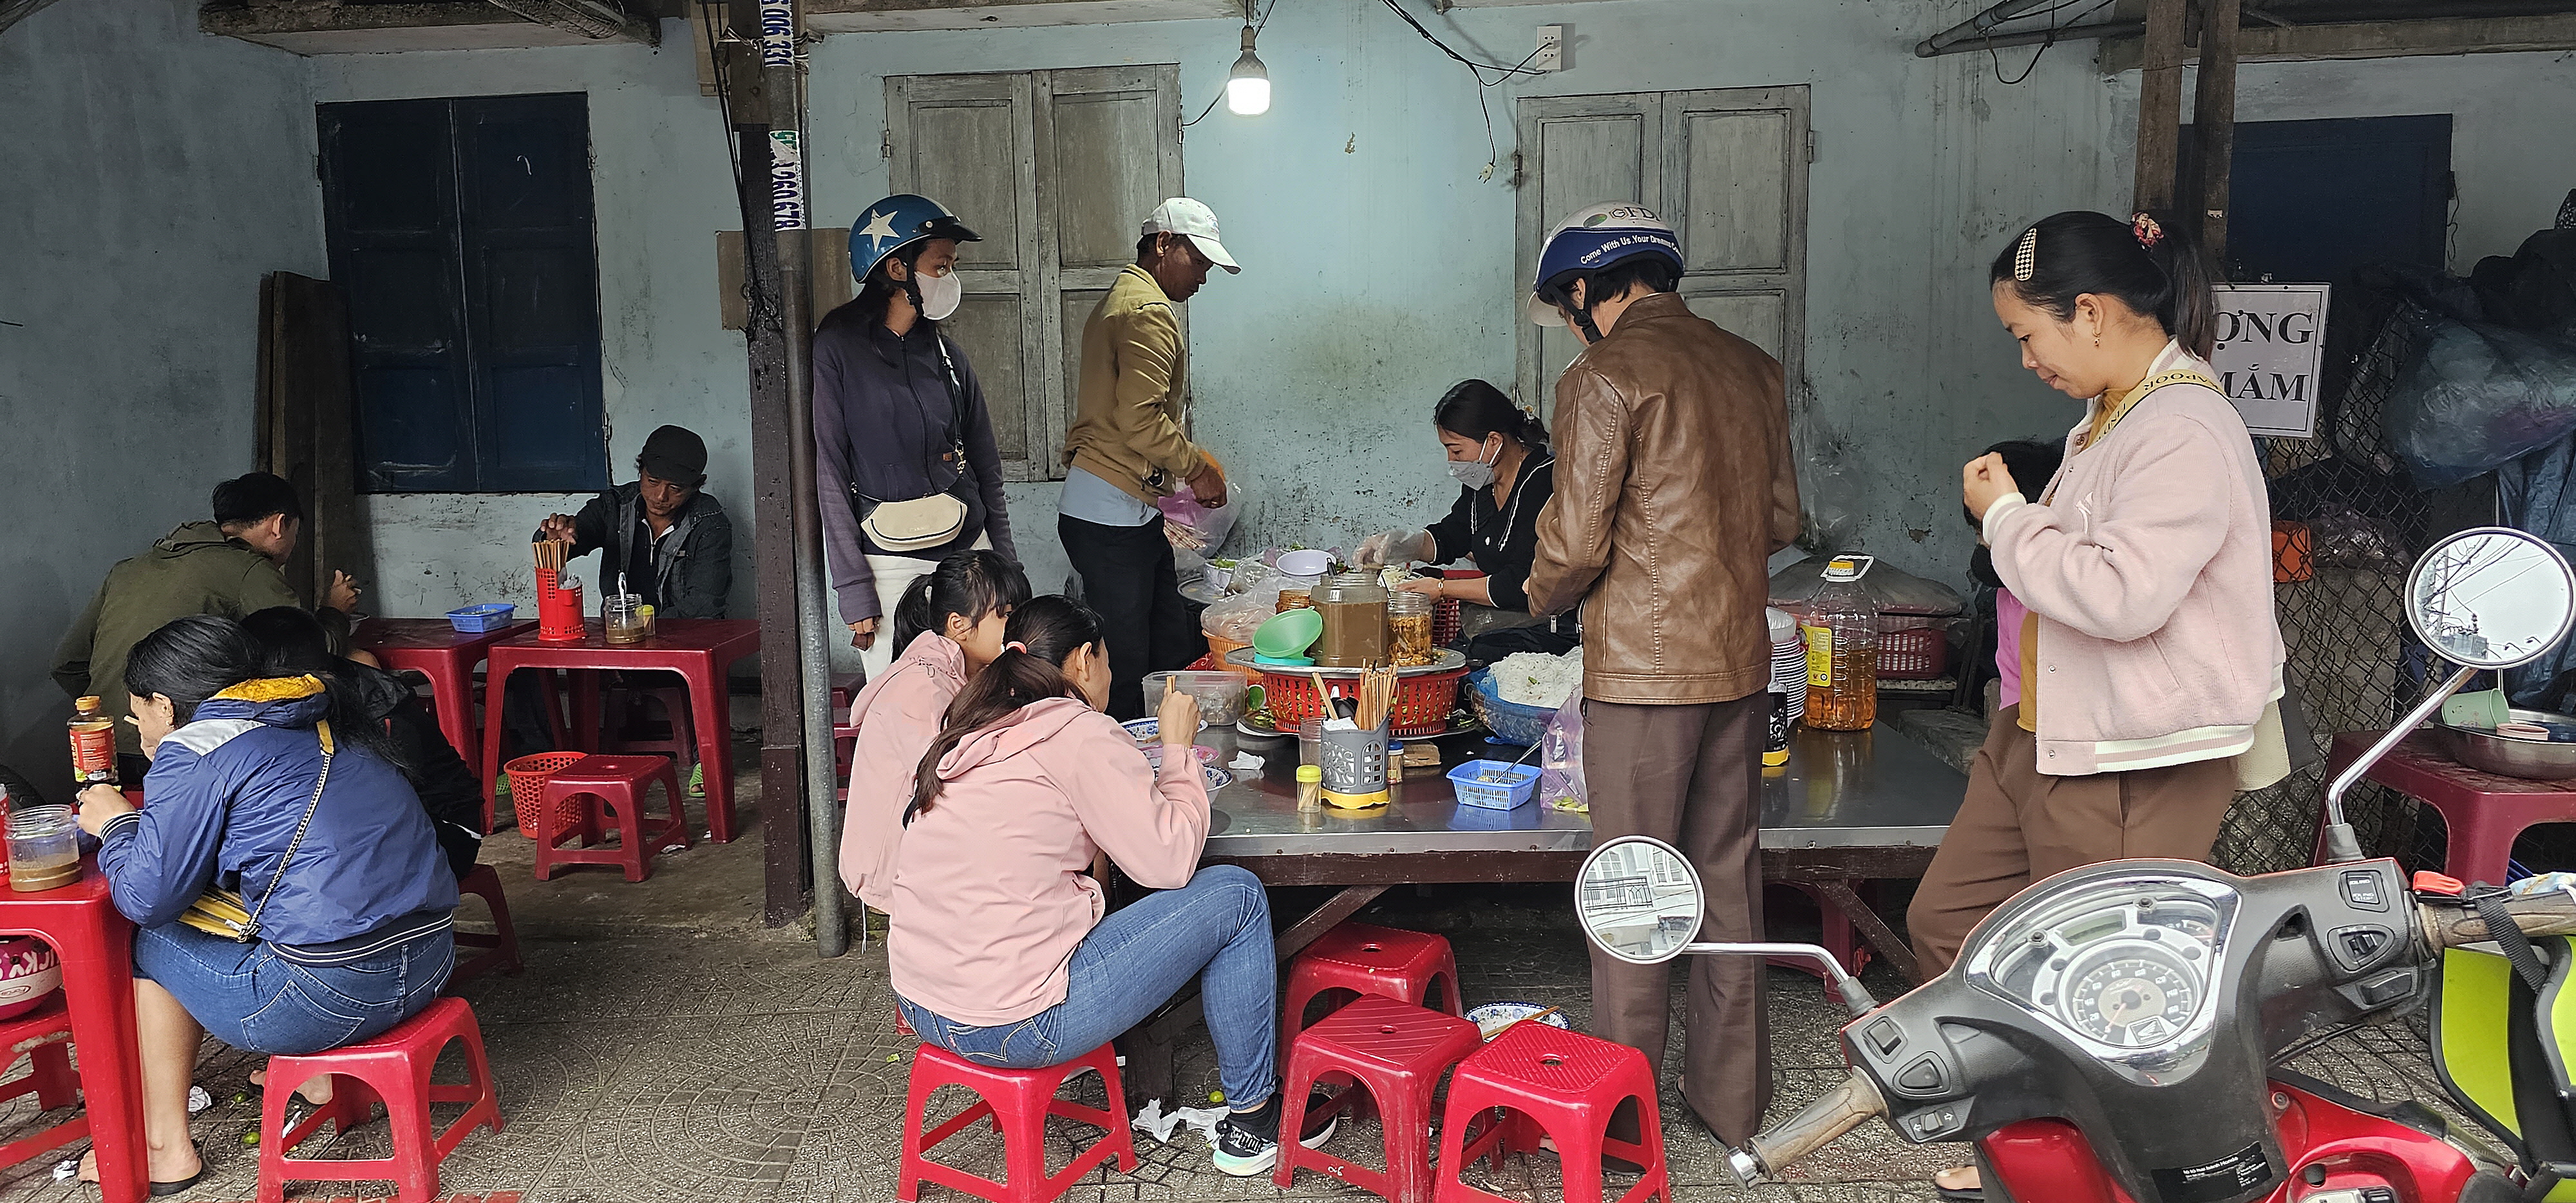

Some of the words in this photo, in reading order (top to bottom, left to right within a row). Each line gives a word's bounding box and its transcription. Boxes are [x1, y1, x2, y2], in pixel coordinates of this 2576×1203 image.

[764, 40, 792, 66] 331
[1580, 249, 1602, 265] Come
[1601, 240, 1620, 253] With
[2220, 1156, 2239, 1166] Honda
